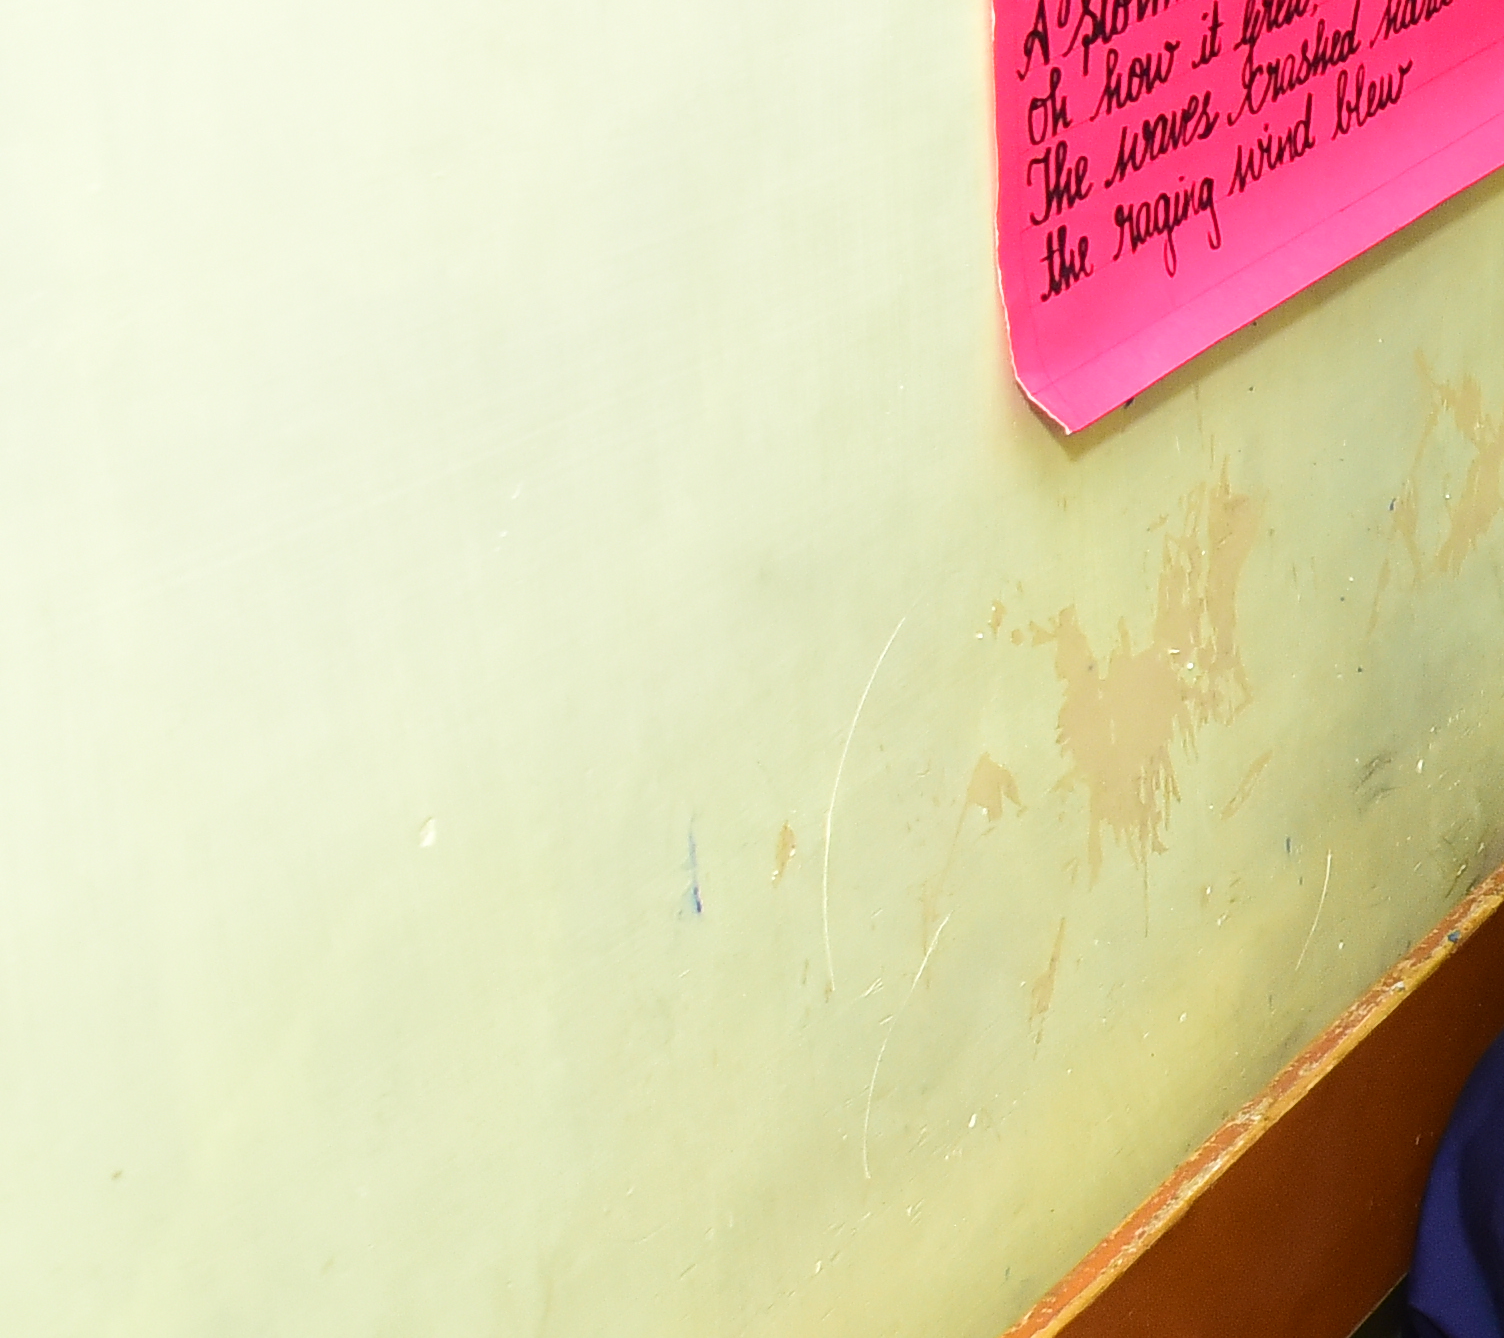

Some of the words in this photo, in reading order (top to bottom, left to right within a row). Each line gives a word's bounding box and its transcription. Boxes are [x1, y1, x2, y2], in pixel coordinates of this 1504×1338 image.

[1040, 224, 1095, 303] the
[1112, 175, 1221, 279] raging
[1228, 93, 1316, 197] wind
[1331, 60, 1414, 141] blew
